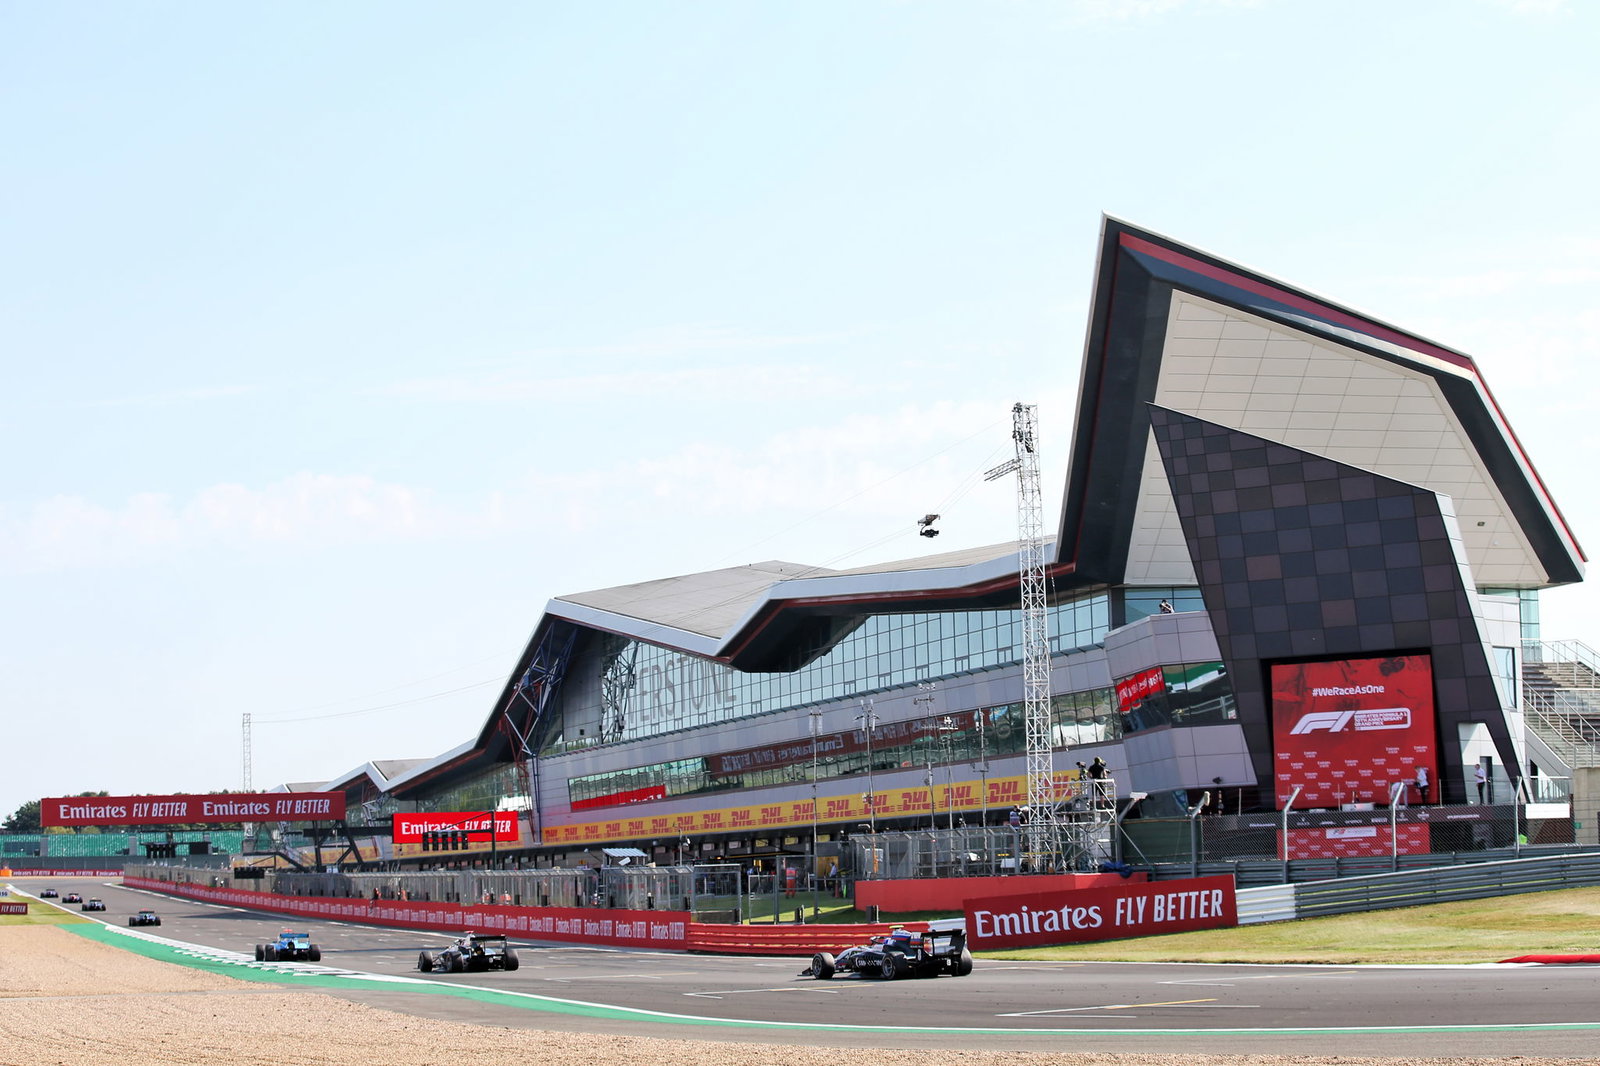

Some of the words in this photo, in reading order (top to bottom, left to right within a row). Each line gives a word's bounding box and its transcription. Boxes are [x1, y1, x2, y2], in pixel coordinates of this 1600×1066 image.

[1312, 685, 1384, 696] #WeRaceAsOne
[902, 791, 929, 811] DHL
[944, 786, 974, 808] DHL
[989, 782, 1020, 804] DHL
[60, 804, 126, 819] Emirates
[133, 802, 150, 817] FLY
[152, 802, 187, 816] BETTER
[203, 801, 270, 816] Emirates
[276, 800, 294, 815] FLY
[295, 800, 330, 814] BETTER
[732, 810, 752, 827] DHL
[760, 807, 783, 824] DHL
[793, 803, 816, 822] DHL
[826, 800, 851, 818] DHL
[702, 813, 721, 830] DHL
[975, 904, 1104, 939] Emirates
[1115, 896, 1146, 926] FLY
[1153, 889, 1224, 923] BETTER
